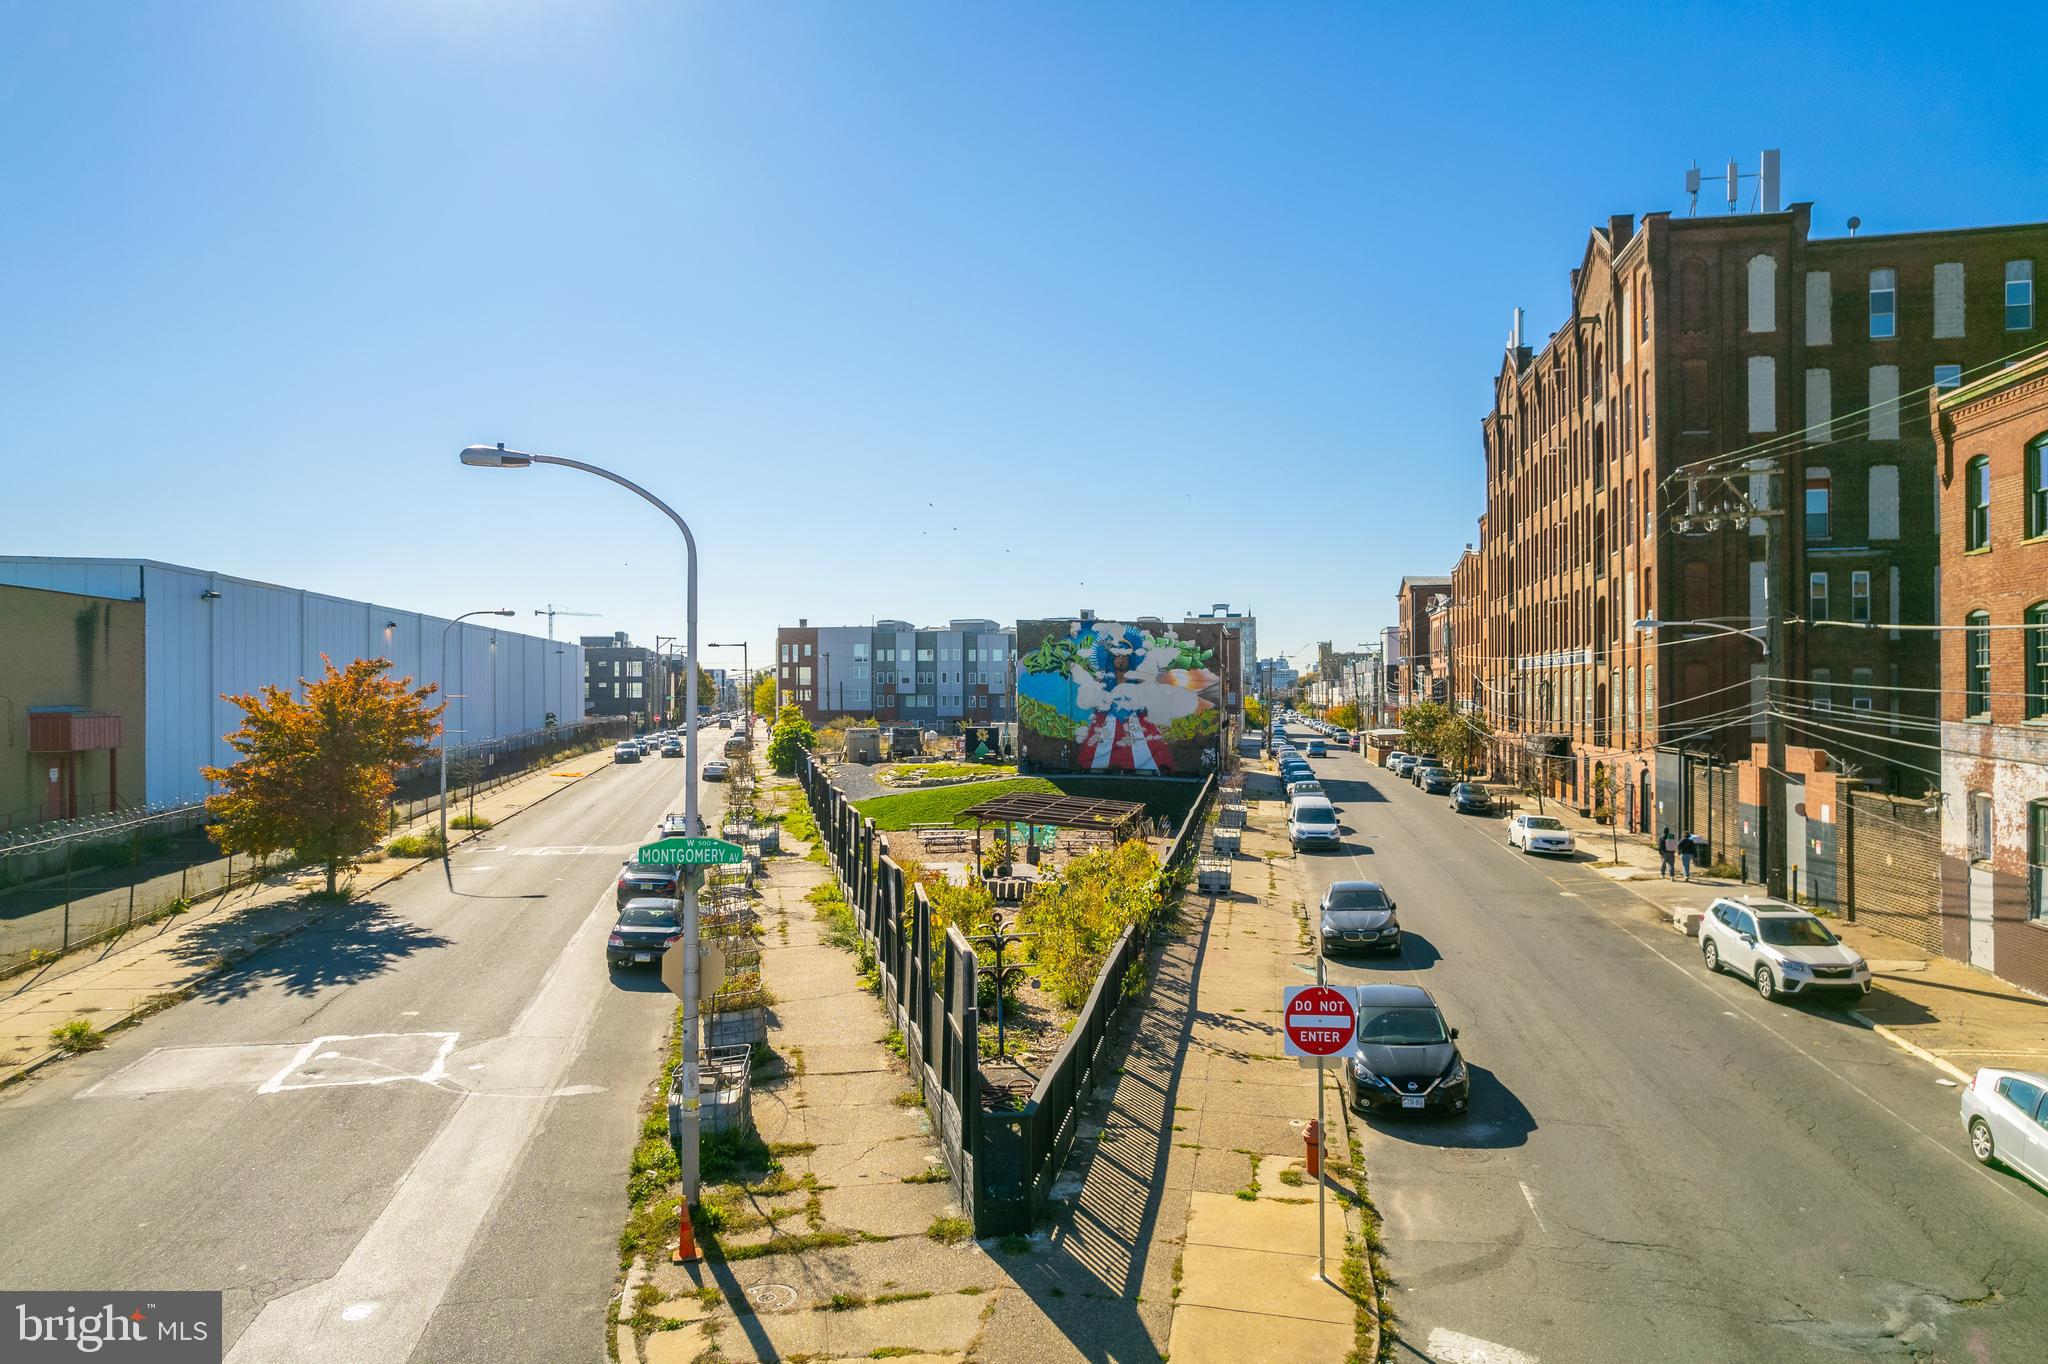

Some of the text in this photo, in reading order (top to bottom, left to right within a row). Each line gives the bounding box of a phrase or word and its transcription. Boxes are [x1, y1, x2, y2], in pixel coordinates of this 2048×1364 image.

[642, 848, 739, 863] MONTGOMERY AV
[1295, 1000, 1344, 1012] DO NOT
[1300, 1031, 1340, 1042] ENTER
